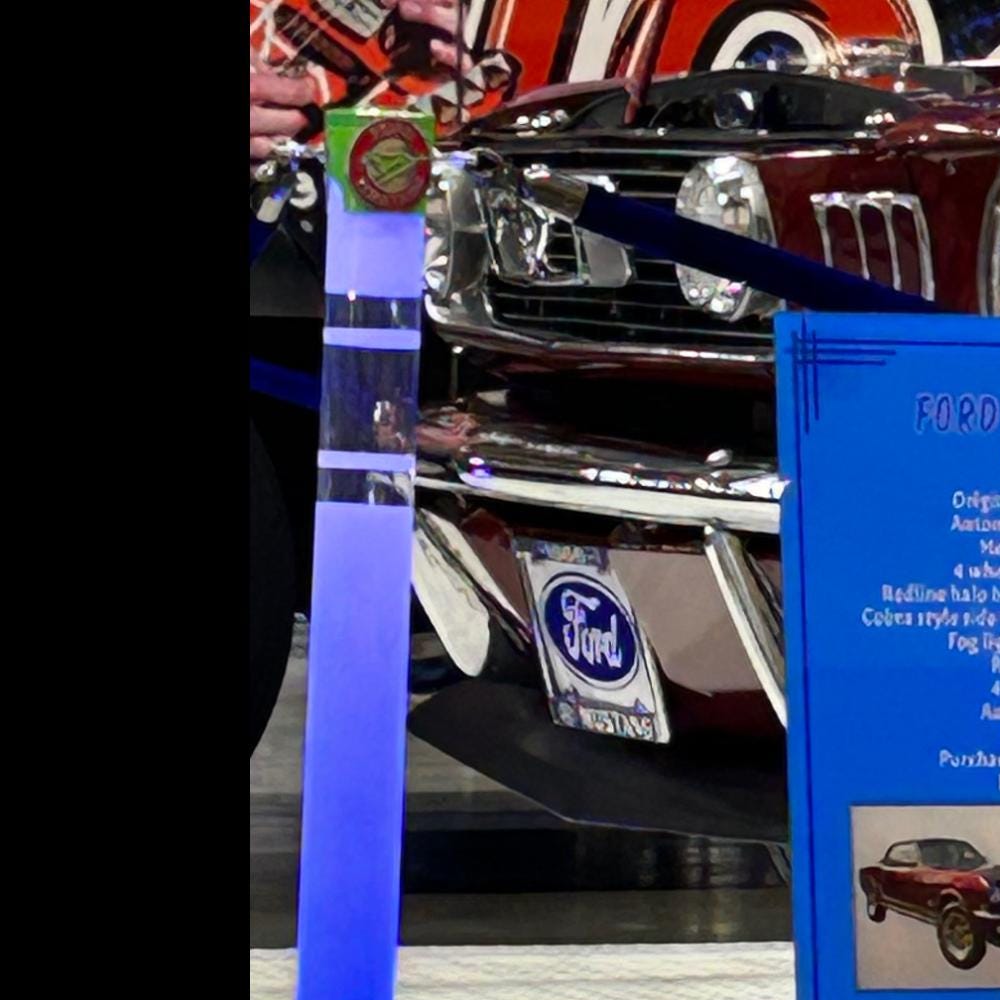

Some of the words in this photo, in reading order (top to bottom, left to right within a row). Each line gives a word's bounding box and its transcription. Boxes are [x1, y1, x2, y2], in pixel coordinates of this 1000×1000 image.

[915, 392, 1000, 435] FORD
[953, 563, 964, 580] 4
[881, 583, 947, 603] Redline
[951, 583, 988, 603] halo
[560, 588, 623, 668] Ford
[861, 606, 913, 627] Cobra
[917, 607, 959, 630] style
[962, 607, 997, 627] side
[948, 631, 980, 655] Fog
